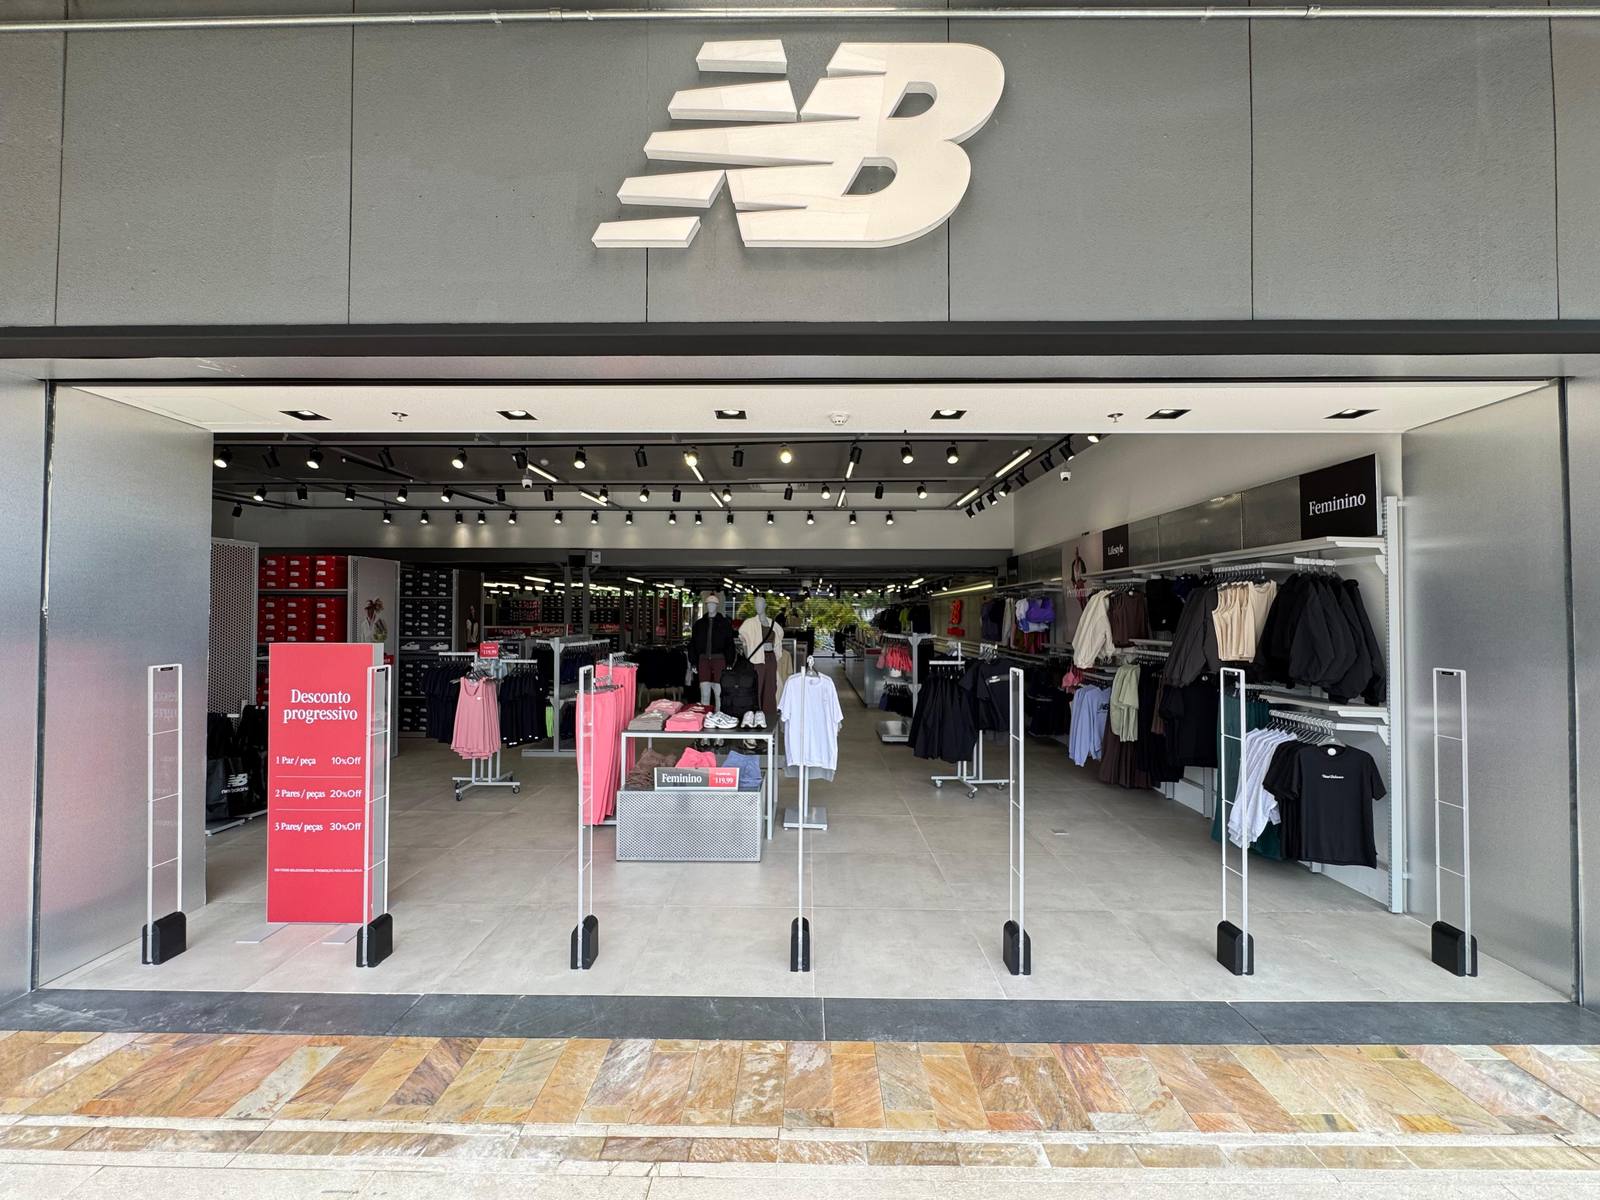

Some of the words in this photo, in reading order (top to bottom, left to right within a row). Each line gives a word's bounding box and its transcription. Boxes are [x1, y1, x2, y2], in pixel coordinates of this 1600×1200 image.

[1308, 493, 1366, 516] Feminino
[290, 689, 351, 704] Desconto
[283, 706, 358, 724] progressivo
[281, 756, 294, 765] Par
[300, 757, 317, 766] peça
[661, 773, 702, 784] Feminino
[275, 789, 280, 798] 2
[281, 789, 300, 798] Pares
[306, 790, 326, 799] peças
[303, 823, 324, 832] peças
